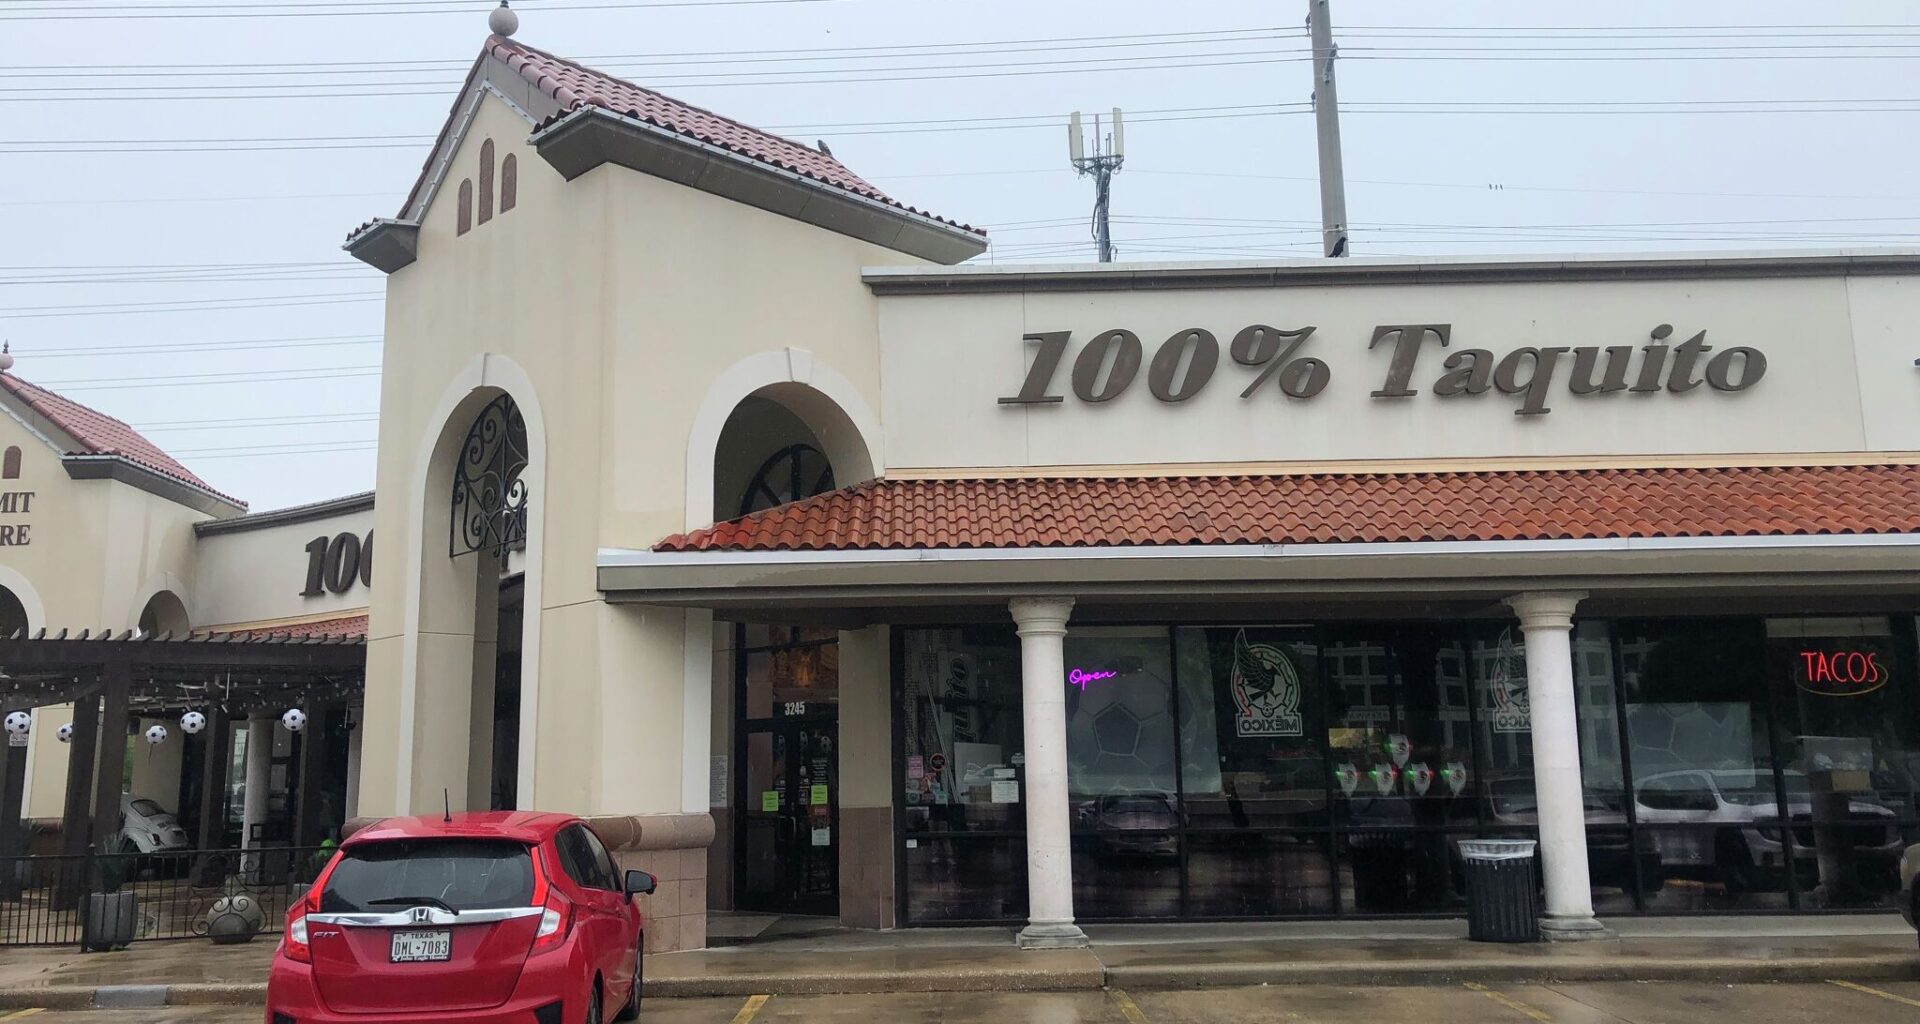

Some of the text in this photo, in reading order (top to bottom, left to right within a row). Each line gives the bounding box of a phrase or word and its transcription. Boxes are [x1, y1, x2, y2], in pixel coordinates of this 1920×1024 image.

[998, 323, 1768, 416] 100% Taquito
[1069, 668, 1117, 691] Open
[1800, 650, 1878, 683] TACOS
[784, 701, 806, 717] 3245
